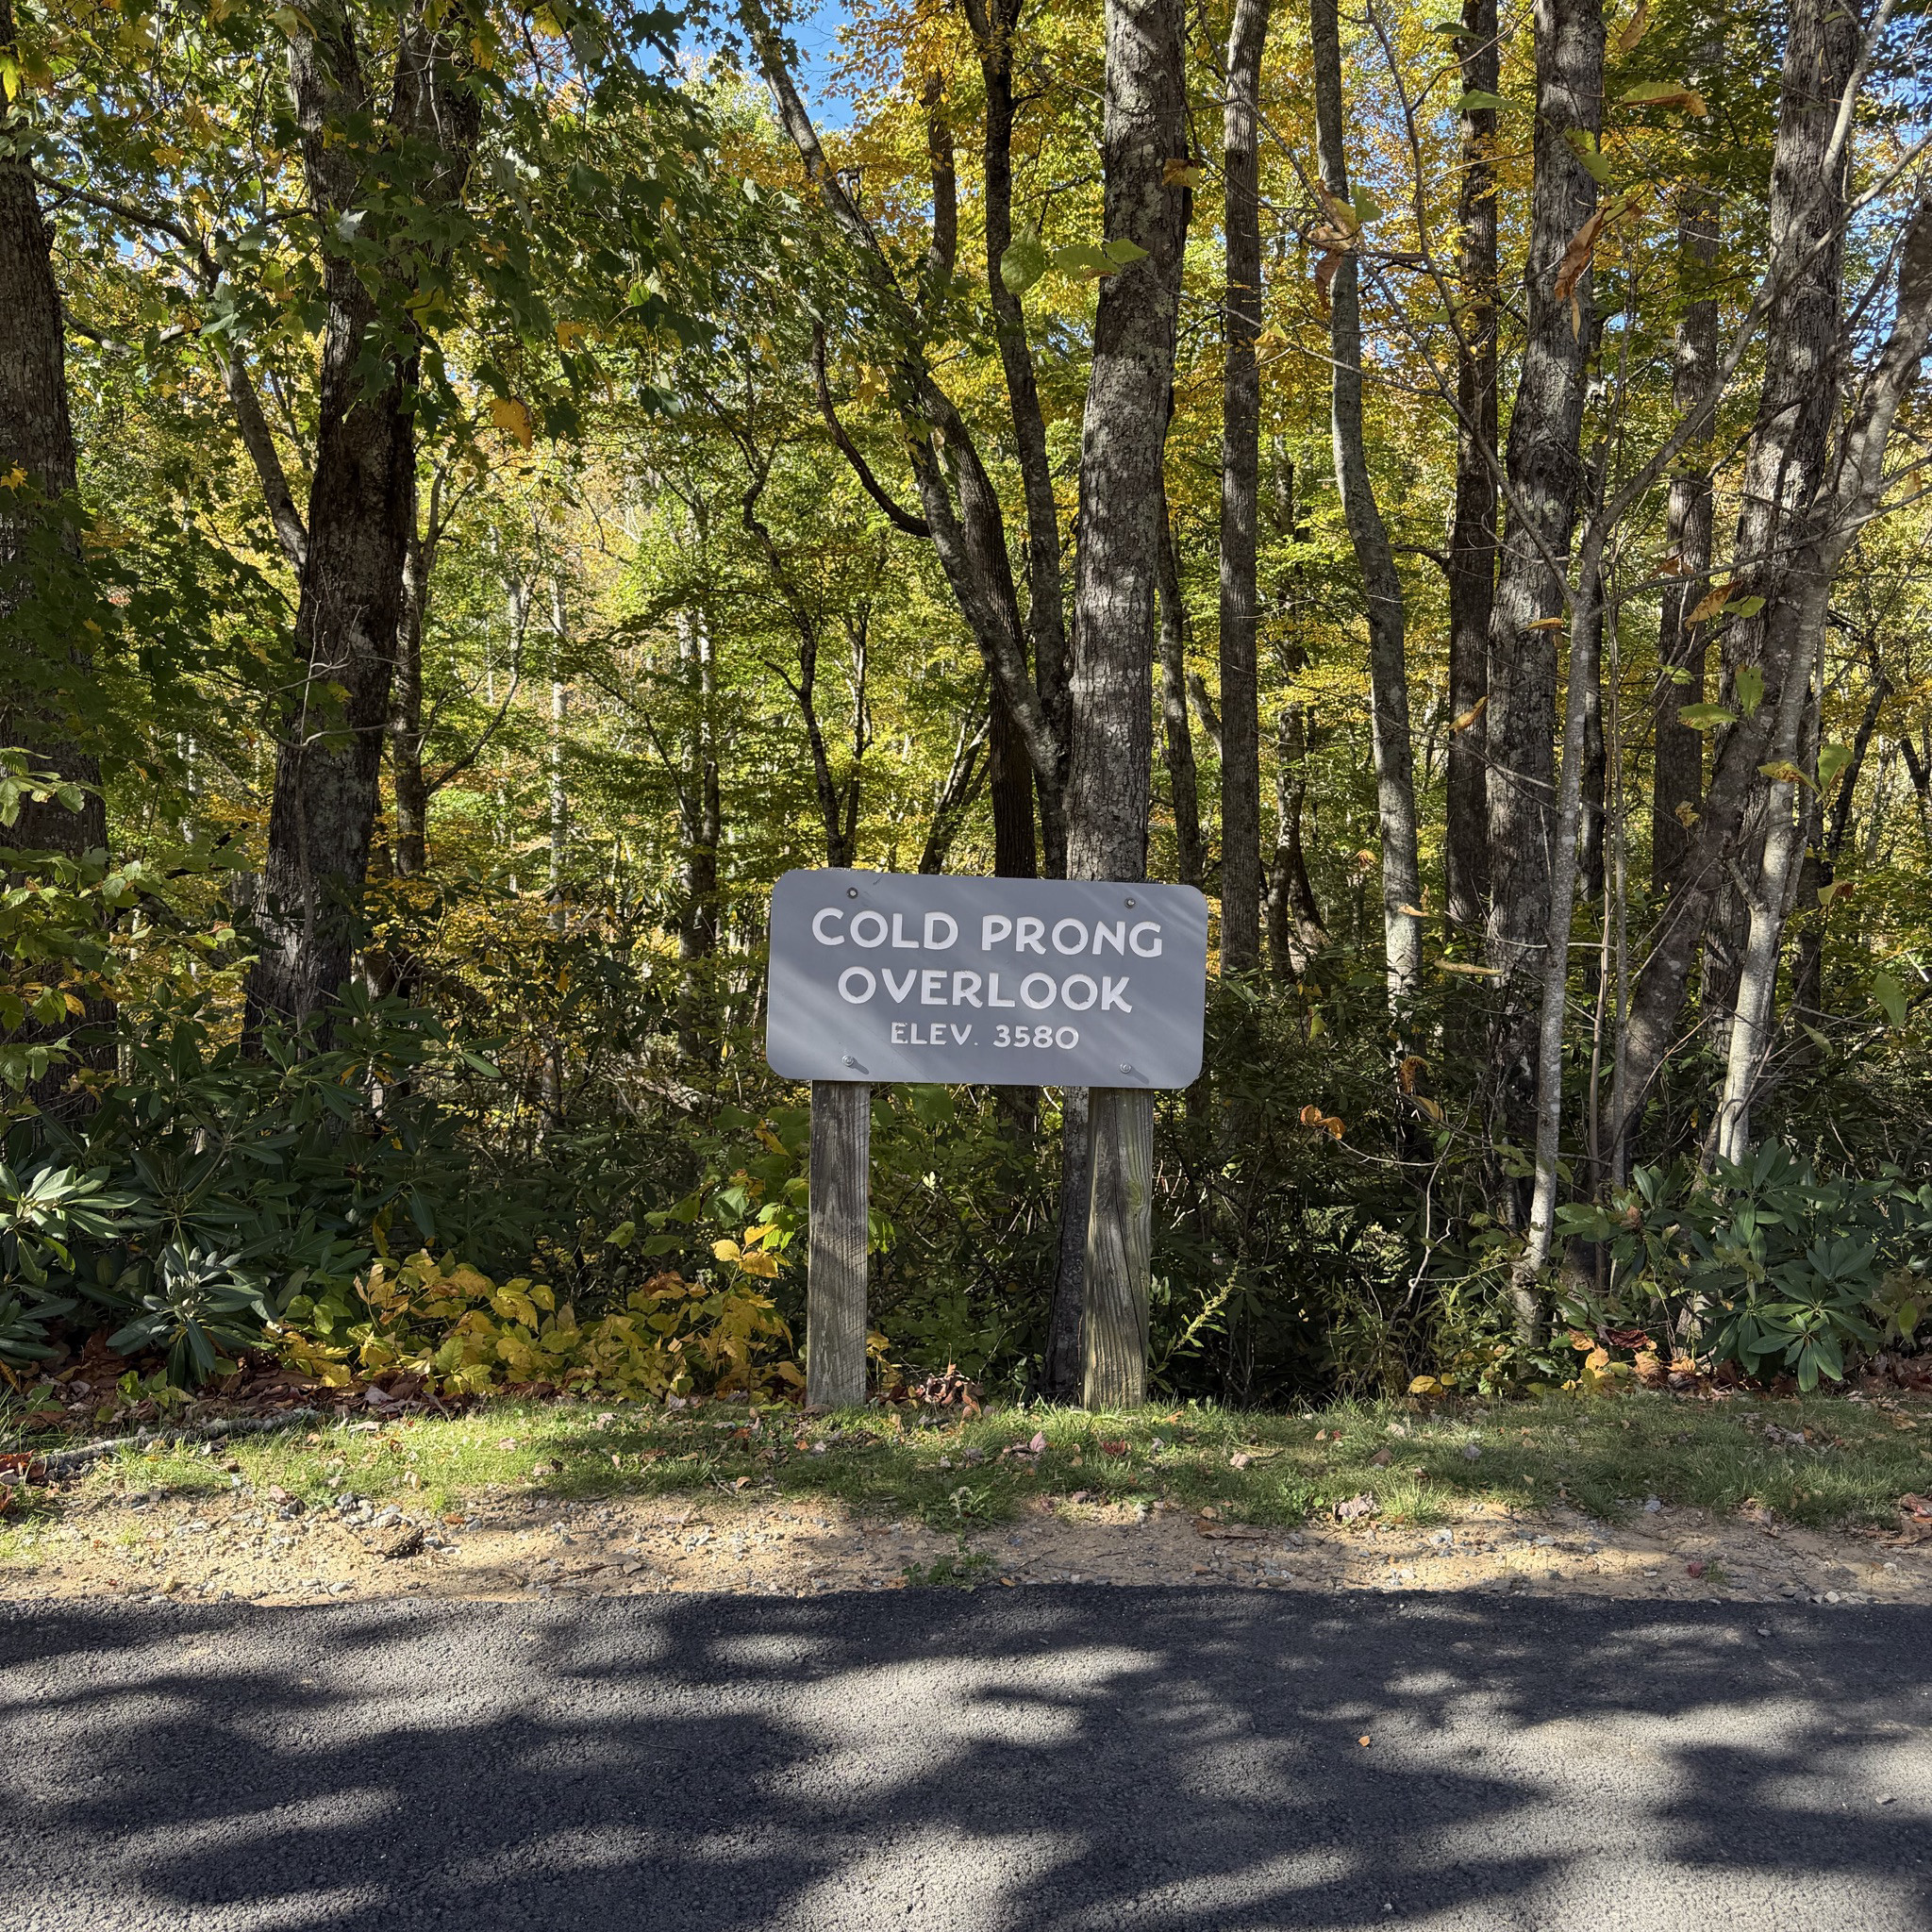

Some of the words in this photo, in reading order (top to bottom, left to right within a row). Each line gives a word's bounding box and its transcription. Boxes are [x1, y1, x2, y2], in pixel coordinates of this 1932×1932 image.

[811, 908, 958, 950] COLD
[981, 914, 1163, 958] PRONG
[838, 965, 1133, 1014] OVERLOOK
[891, 1022, 978, 1046] ELEV.
[992, 1024, 1080, 1050] 3580
